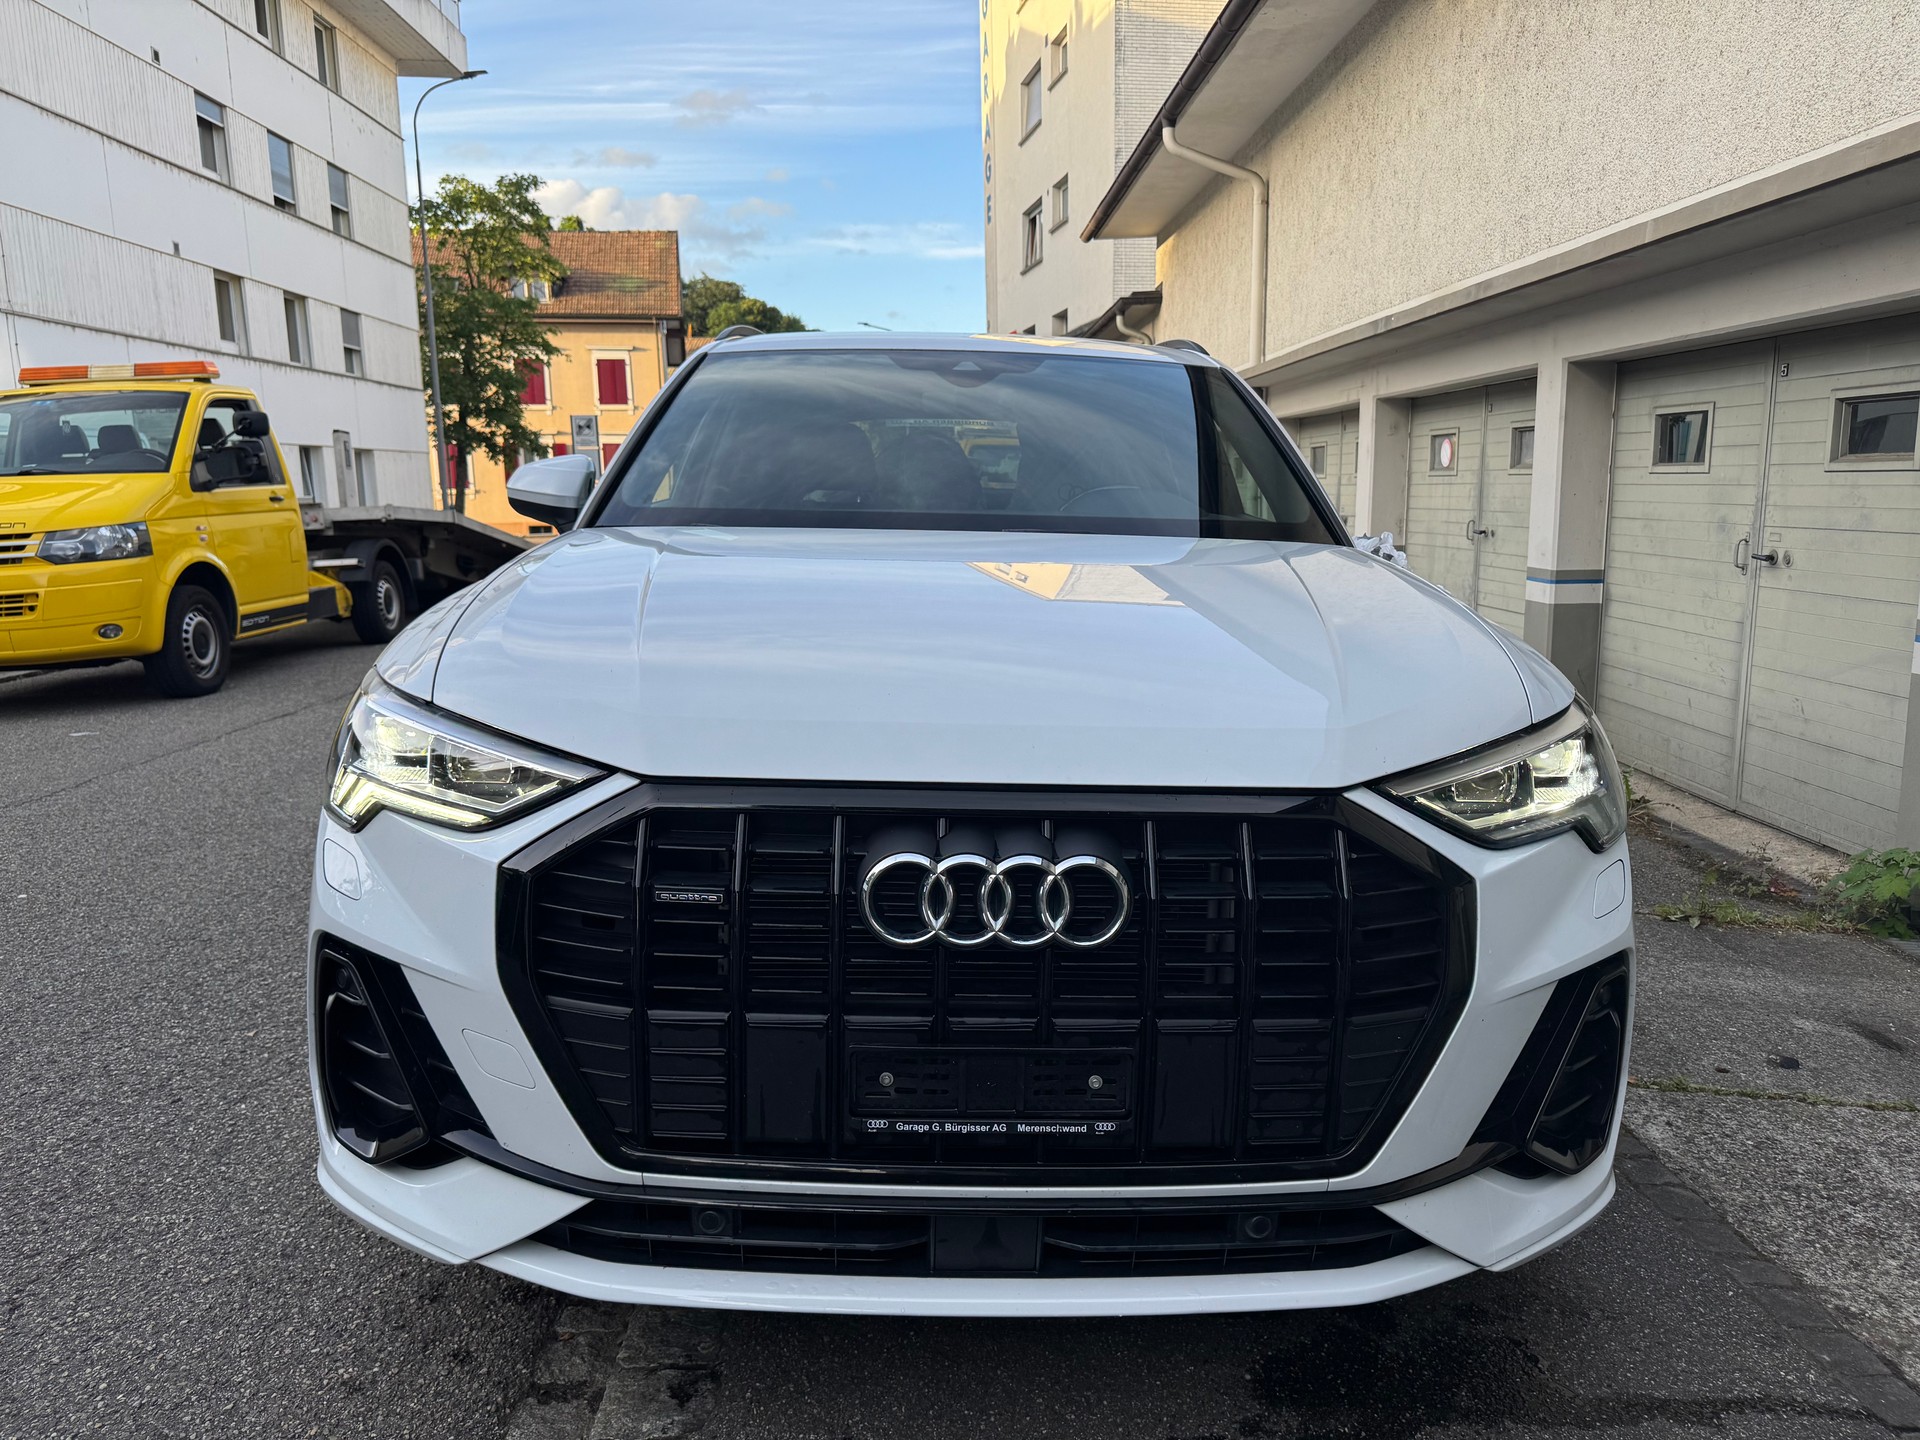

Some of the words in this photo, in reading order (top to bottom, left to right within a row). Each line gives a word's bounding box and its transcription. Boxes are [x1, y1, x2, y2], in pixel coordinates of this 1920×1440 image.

[1780, 363, 1788, 376] 5
[660, 893, 718, 902] quattro
[896, 1122, 930, 1133] Garage
[932, 1123, 942, 1131] G.
[945, 1123, 990, 1133] Bürgisser
[992, 1123, 1007, 1132] AG
[1017, 1124, 1087, 1133] Merenschwand
